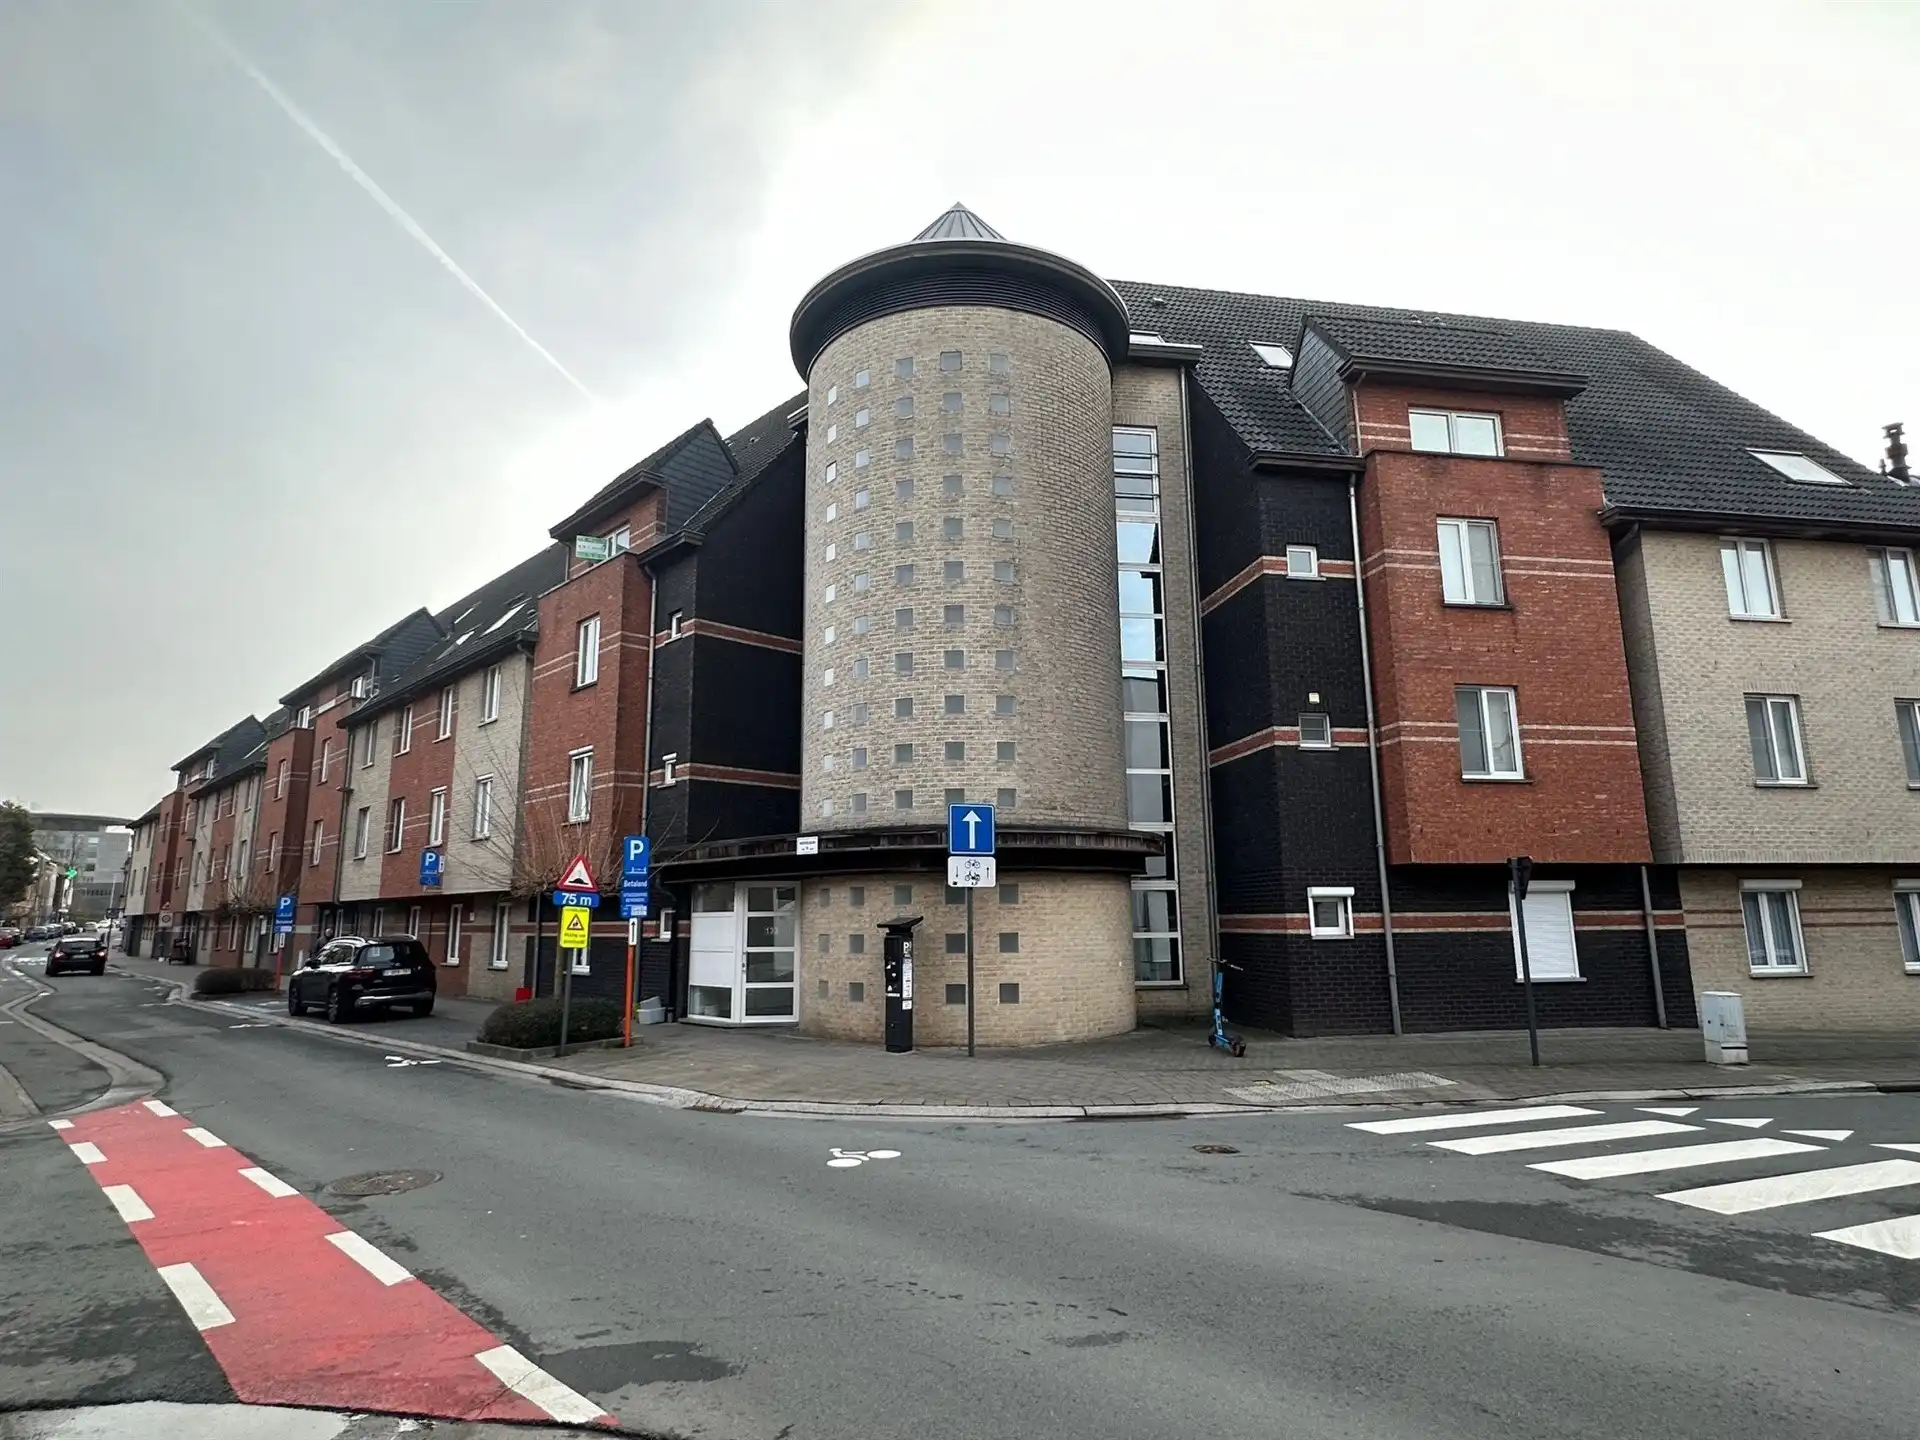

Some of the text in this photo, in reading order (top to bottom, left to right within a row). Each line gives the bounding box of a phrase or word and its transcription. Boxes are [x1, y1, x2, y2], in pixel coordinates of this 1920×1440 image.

[630, 839, 644, 861] P
[424, 852, 436, 867] P
[279, 897, 291, 910] P
[561, 892, 592, 906] 75 m
